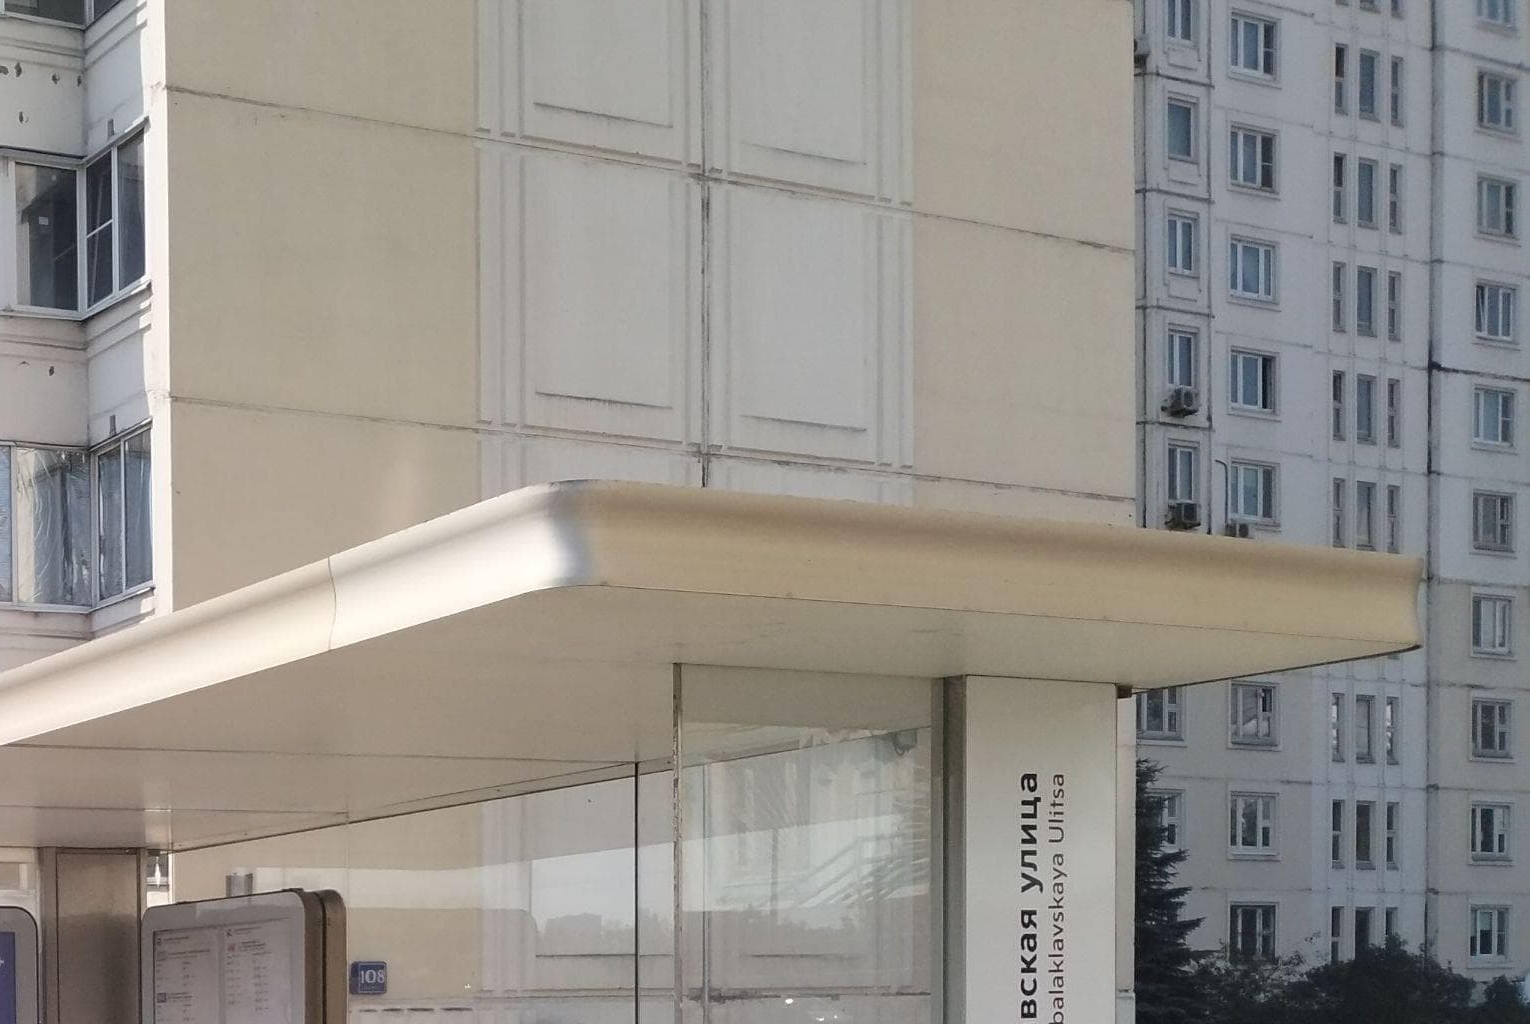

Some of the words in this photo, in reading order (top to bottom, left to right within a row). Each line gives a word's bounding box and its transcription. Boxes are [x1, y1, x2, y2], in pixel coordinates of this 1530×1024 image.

[1019, 771, 1044, 894] улица
[1048, 772, 1066, 843] Ulitsa
[360, 969, 385, 984] 108
